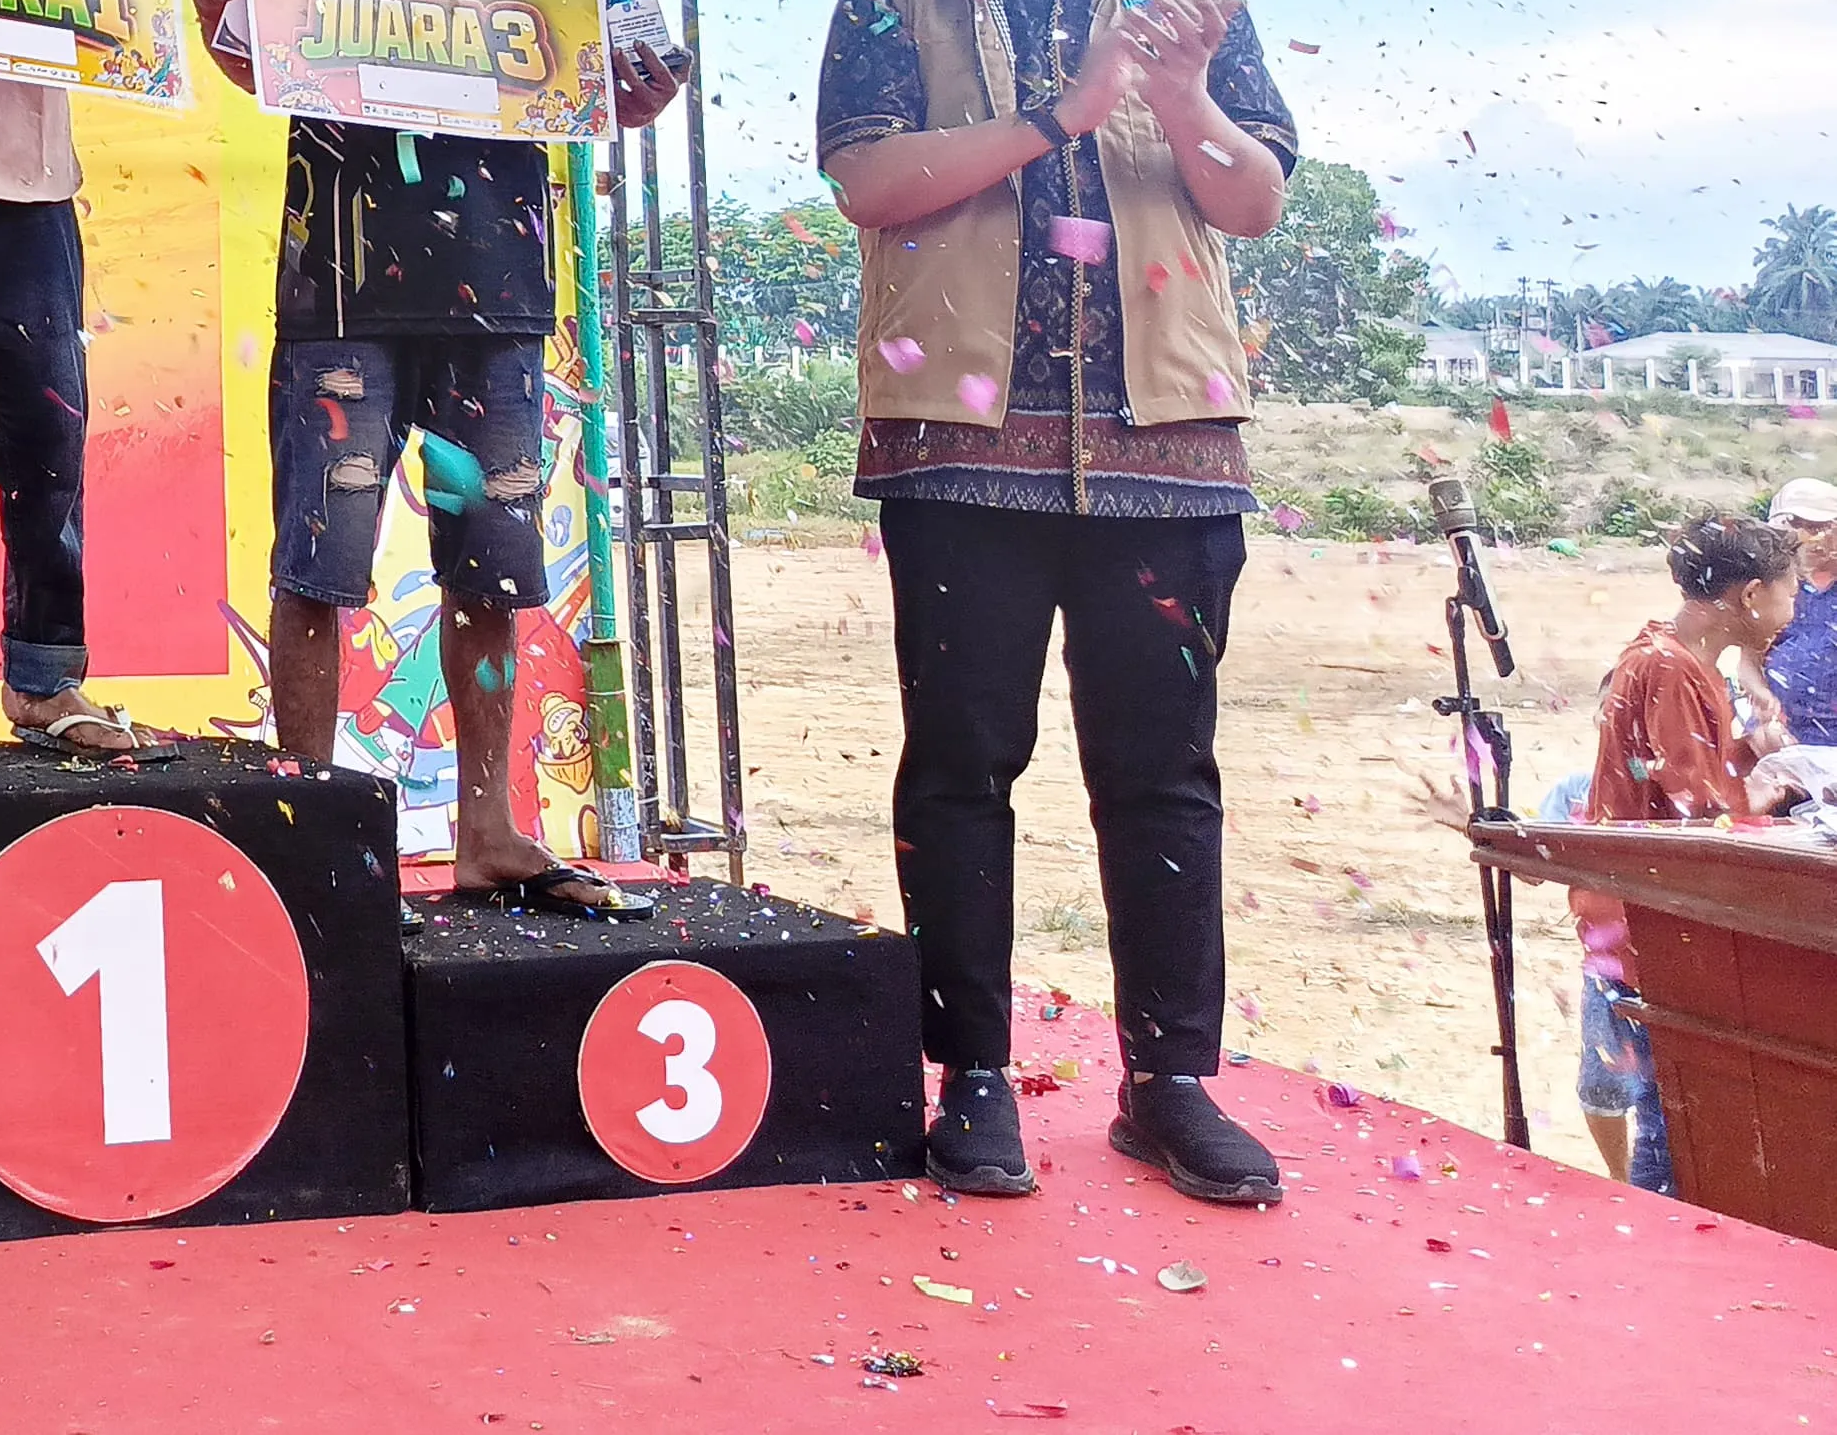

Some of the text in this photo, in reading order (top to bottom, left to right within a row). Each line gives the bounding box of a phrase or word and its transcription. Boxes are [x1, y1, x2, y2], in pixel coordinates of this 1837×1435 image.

[489, 9, 547, 82] 3
[36, 879, 172, 1145] 1
[635, 999, 722, 1144] 3
